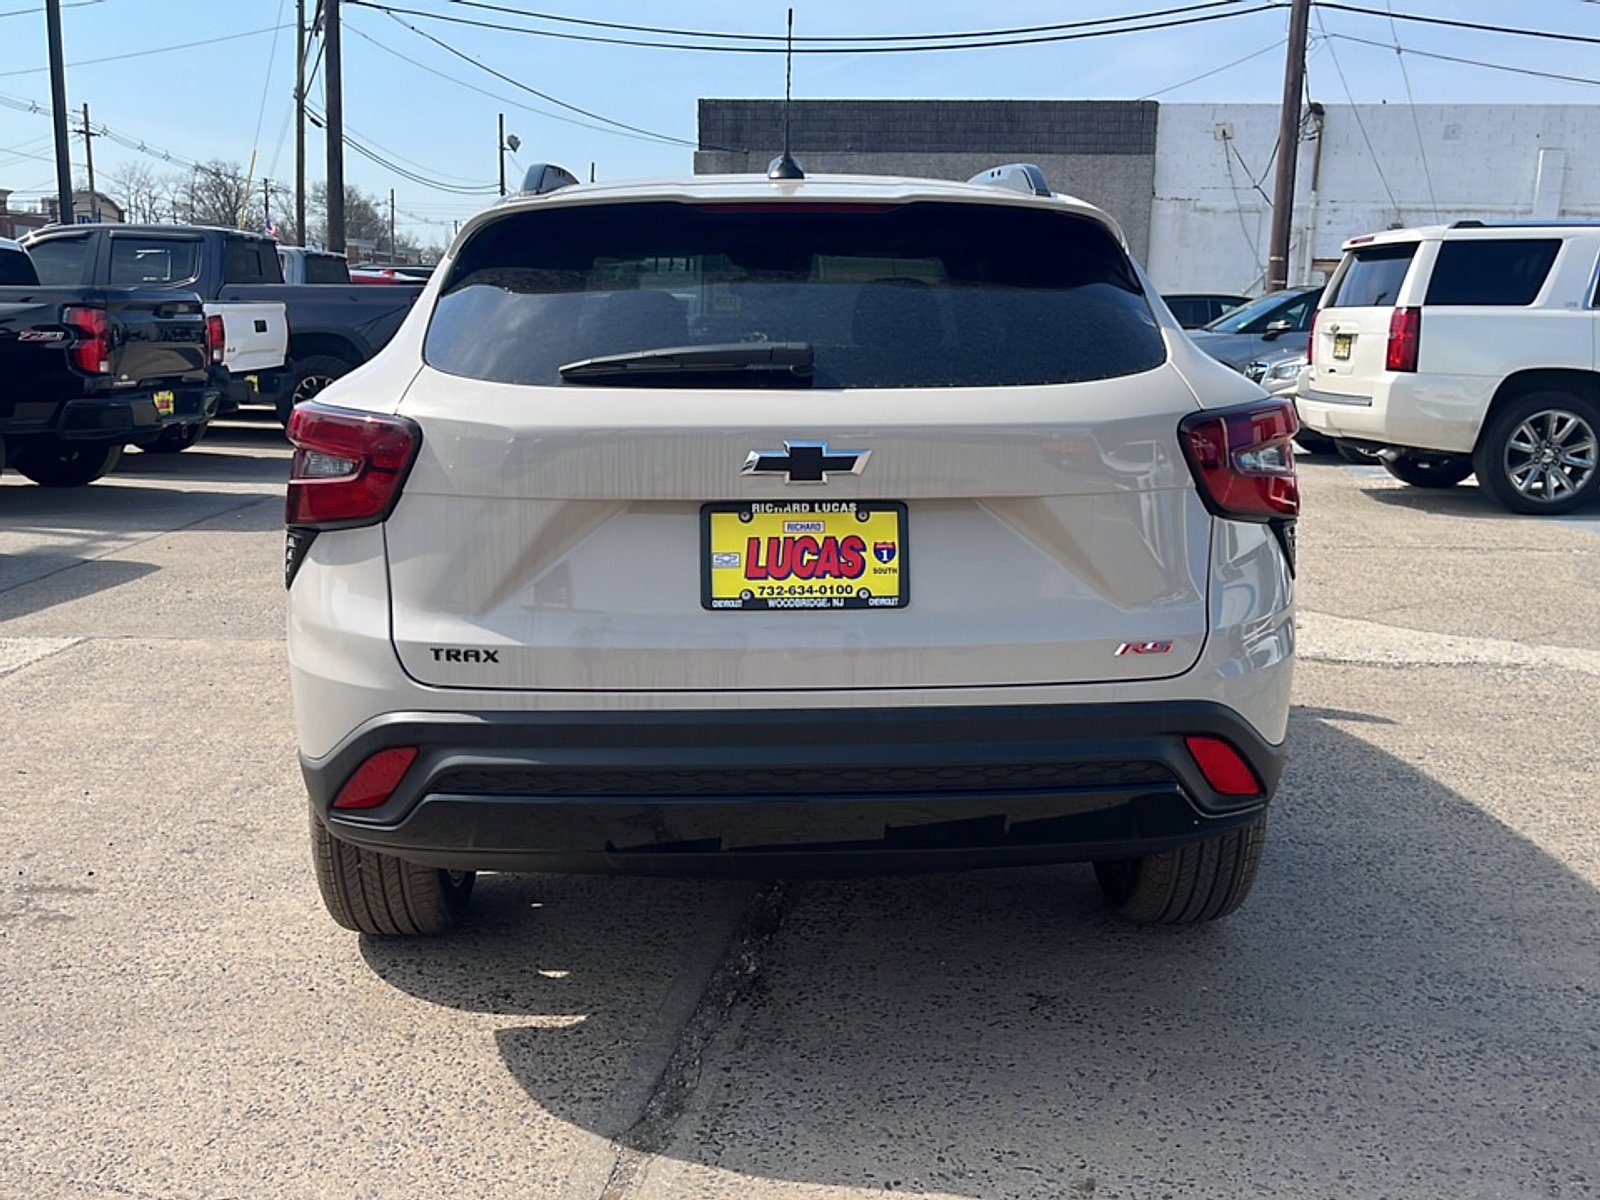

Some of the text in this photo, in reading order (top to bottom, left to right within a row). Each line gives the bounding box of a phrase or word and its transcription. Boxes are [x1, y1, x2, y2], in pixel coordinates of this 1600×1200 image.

[814, 502, 857, 514] LUCAS
[787, 523, 821, 532] RICHARD
[745, 535, 868, 581] LUCAS
[880, 549, 890, 561] 1
[873, 567, 898, 575] SOUTH
[758, 585, 854, 597] 732-634-0100
[831, 598, 845, 608] NJ
[1115, 640, 1173, 656] RS
[430, 648, 500, 663] TRAX
